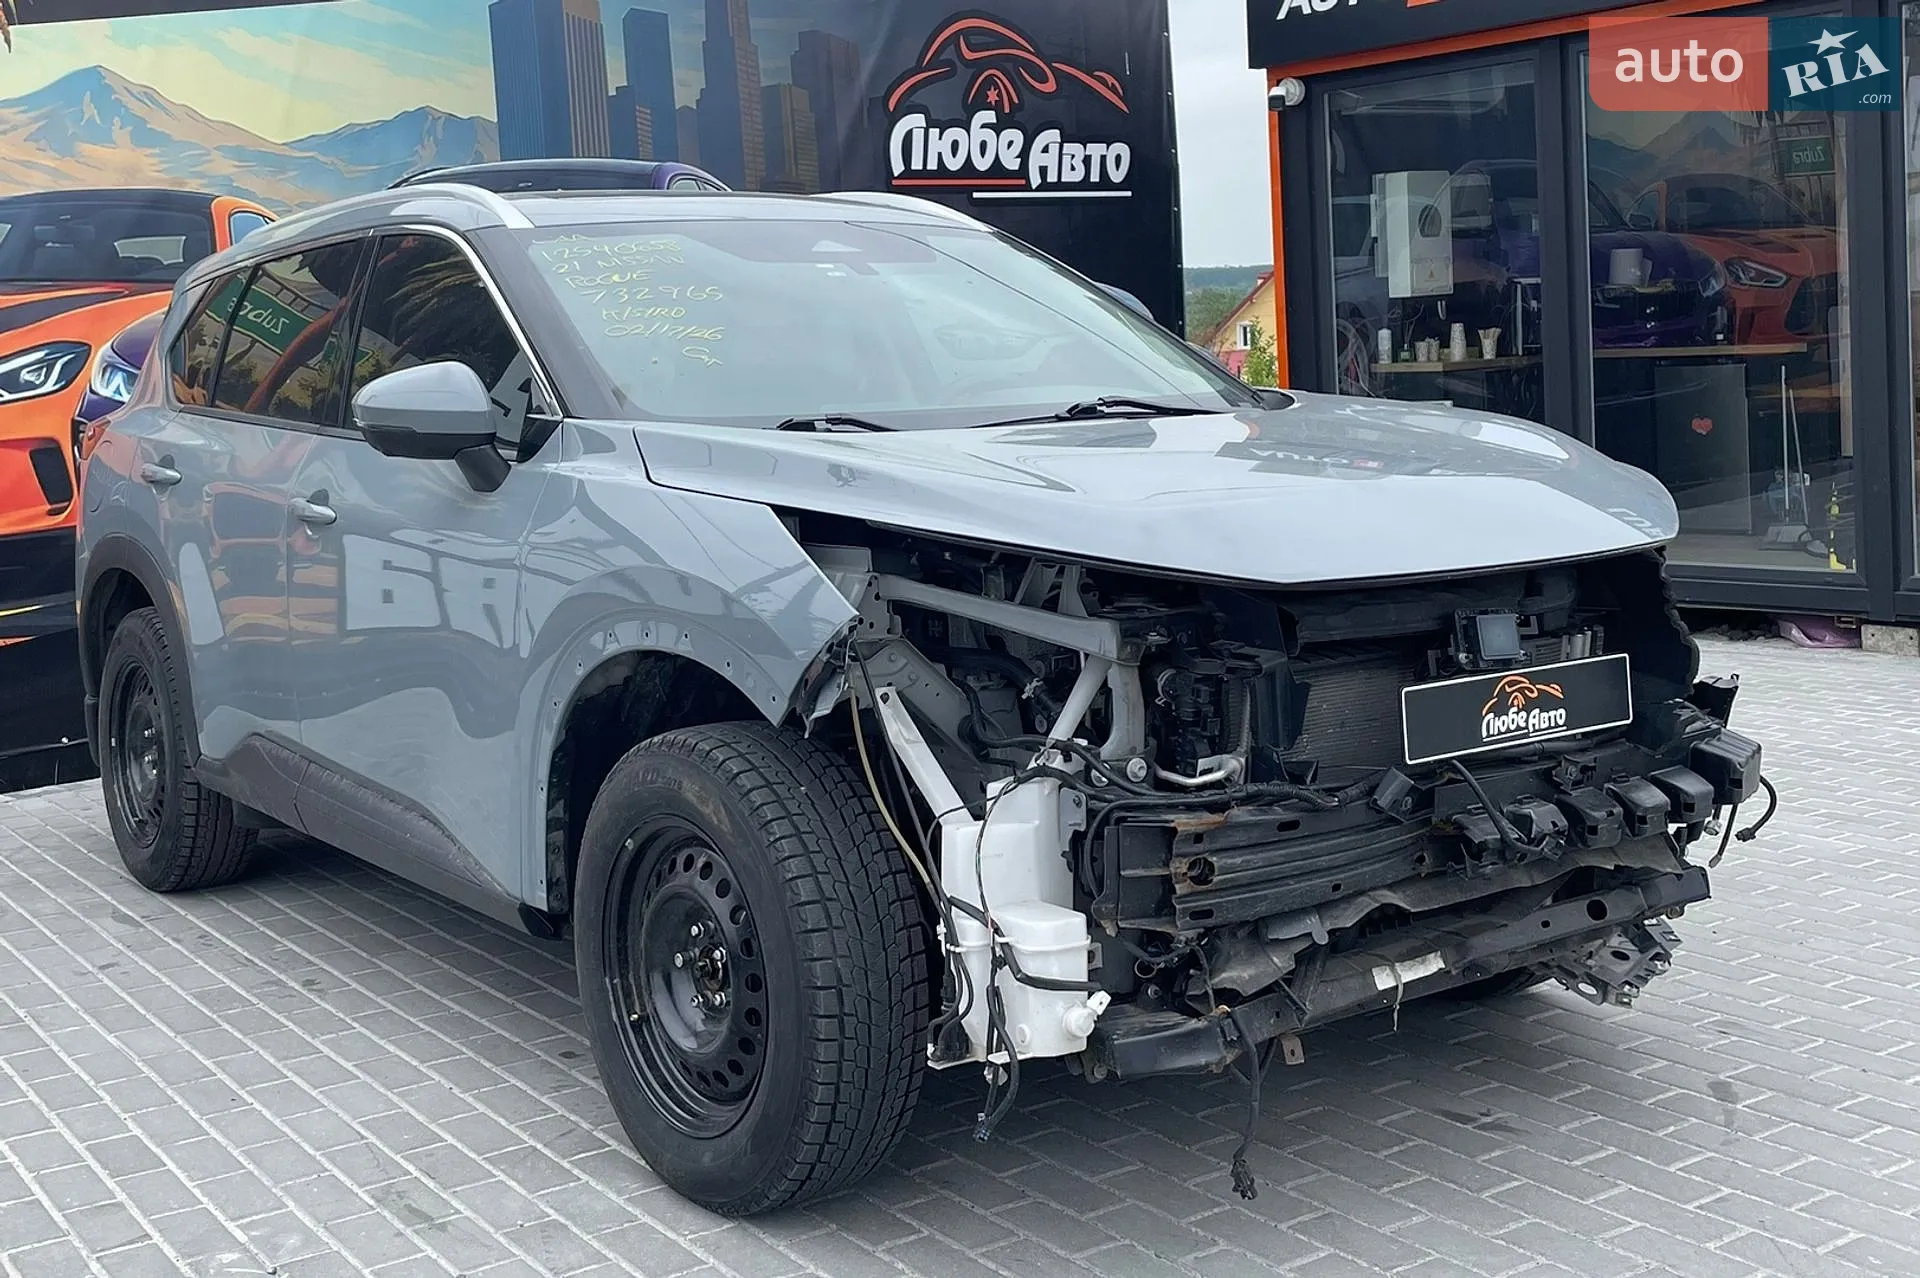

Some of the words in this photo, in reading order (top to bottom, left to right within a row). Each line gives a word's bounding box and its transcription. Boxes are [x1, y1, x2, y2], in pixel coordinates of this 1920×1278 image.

[889, 110, 1024, 177] Любе
[1028, 128, 1131, 190] Авто
[552, 260, 580, 274] 21
[596, 253, 685, 270] NISSAN
[565, 268, 652, 289] ROGUE
[1482, 708, 1527, 738] Любе
[1529, 708, 1566, 732] Авто
